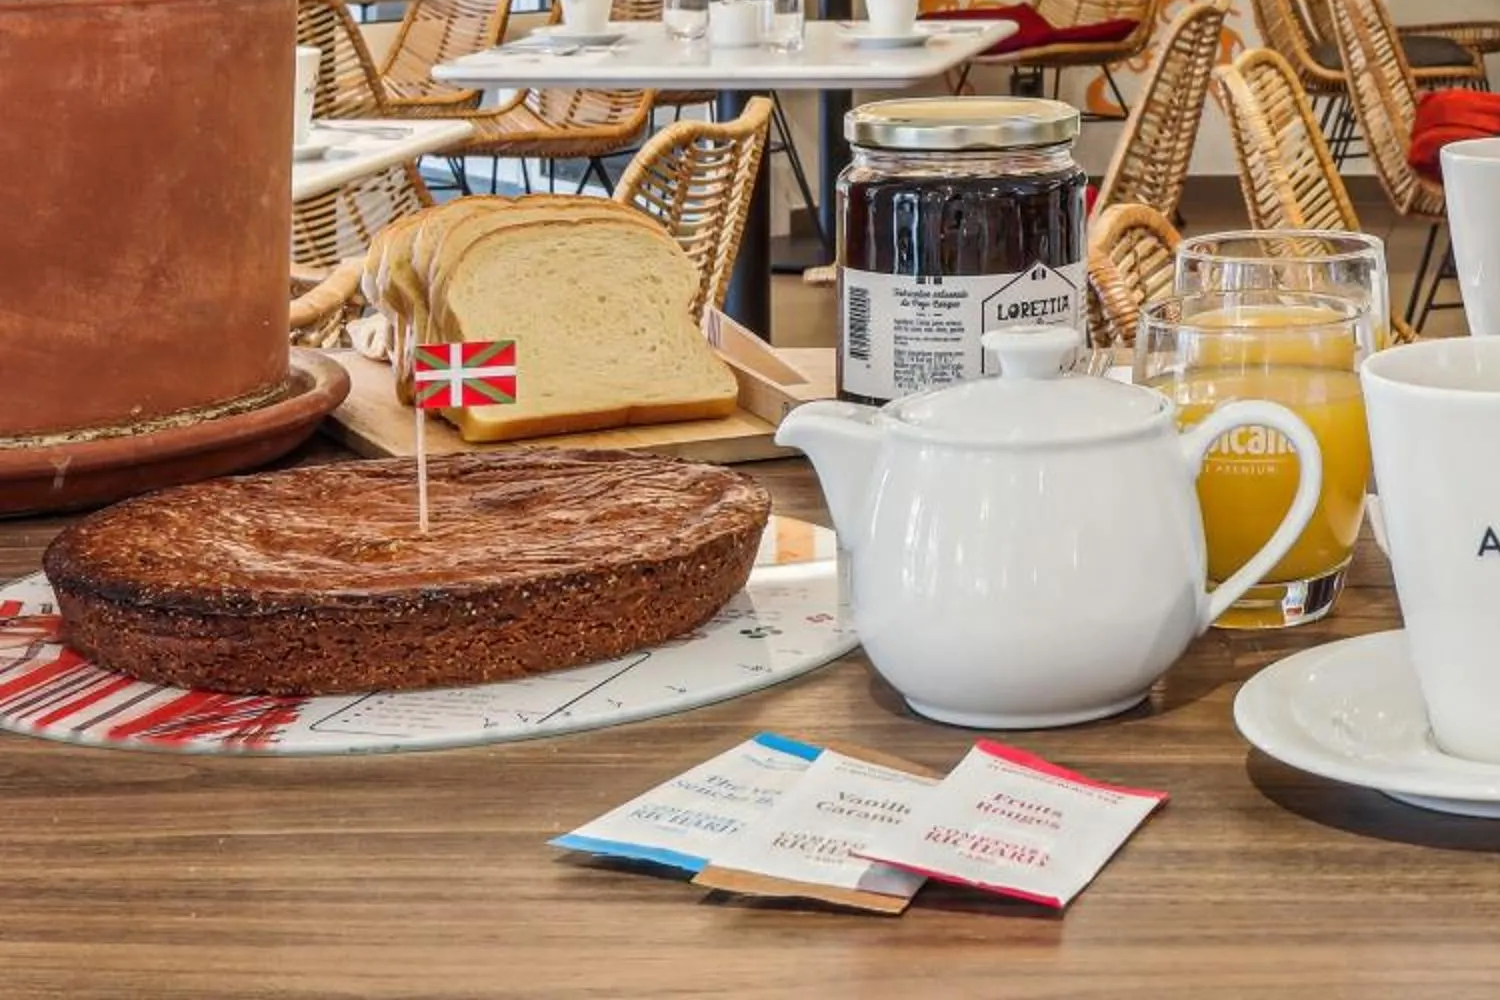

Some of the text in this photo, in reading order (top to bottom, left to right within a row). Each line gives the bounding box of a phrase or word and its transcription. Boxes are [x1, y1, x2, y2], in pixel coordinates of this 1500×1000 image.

[997, 295, 1071, 321] LOREZTIA
[975, 801, 1063, 831] Rouges
[993, 791, 1064, 818] Fruits
